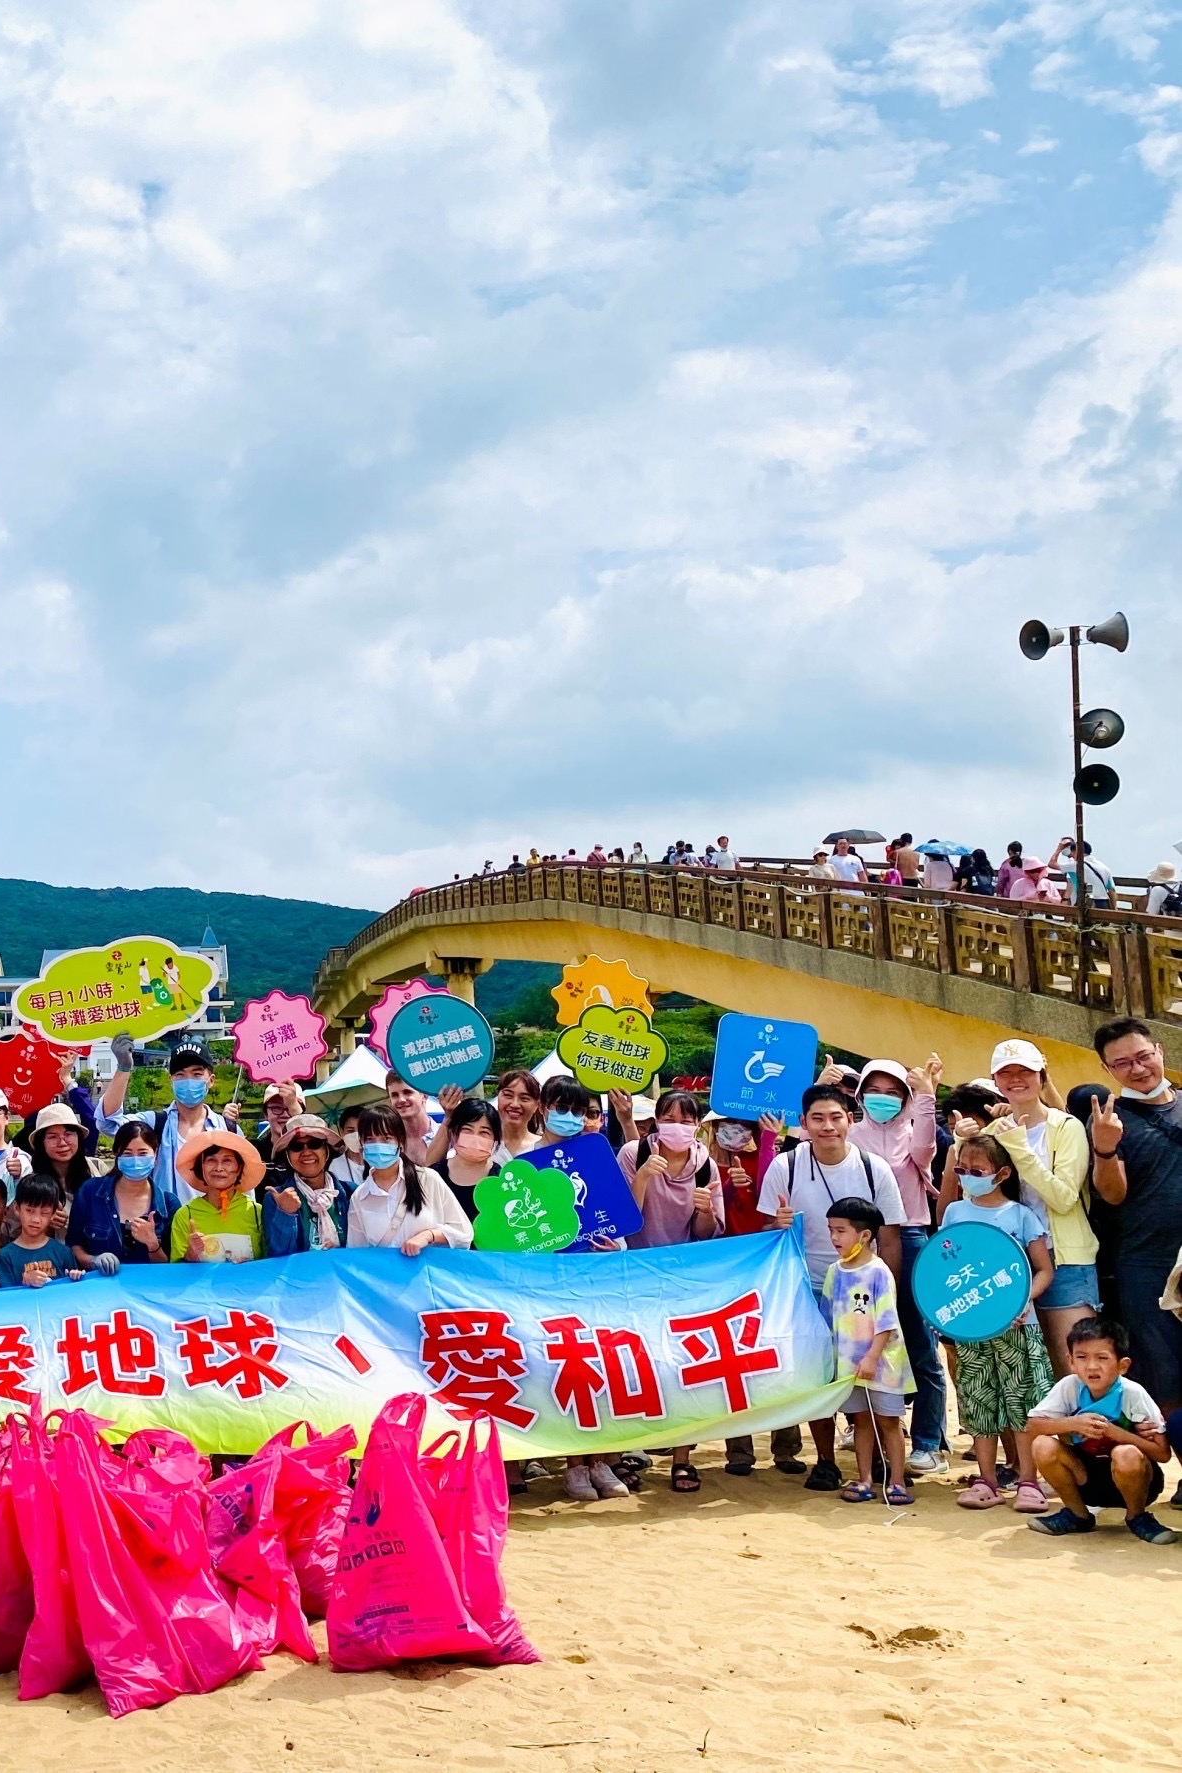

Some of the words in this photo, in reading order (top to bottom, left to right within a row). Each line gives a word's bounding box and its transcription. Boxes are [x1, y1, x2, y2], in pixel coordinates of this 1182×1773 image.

[28, 981, 126, 1010] 每月1小時，
[51, 1000, 142, 1030] 淨灘愛地球
[176, 1044, 202, 1055] JORDAN
[259, 1022, 298, 1051] 淨灘
[401, 1024, 477, 1059] 減塑清海廢
[580, 1029, 651, 1061] 友善地球
[256, 1051, 290, 1069] follow
[294, 1041, 311, 1053] me
[408, 1045, 484, 1077] 讓地球喘息
[576, 1051, 645, 1083] 你我做起
[723, 1100, 747, 1111] water
[514, 1222, 553, 1246] 素食
[944, 1261, 986, 1292] 今天，
[934, 1262, 1023, 1326] 愛地球了嗎？
